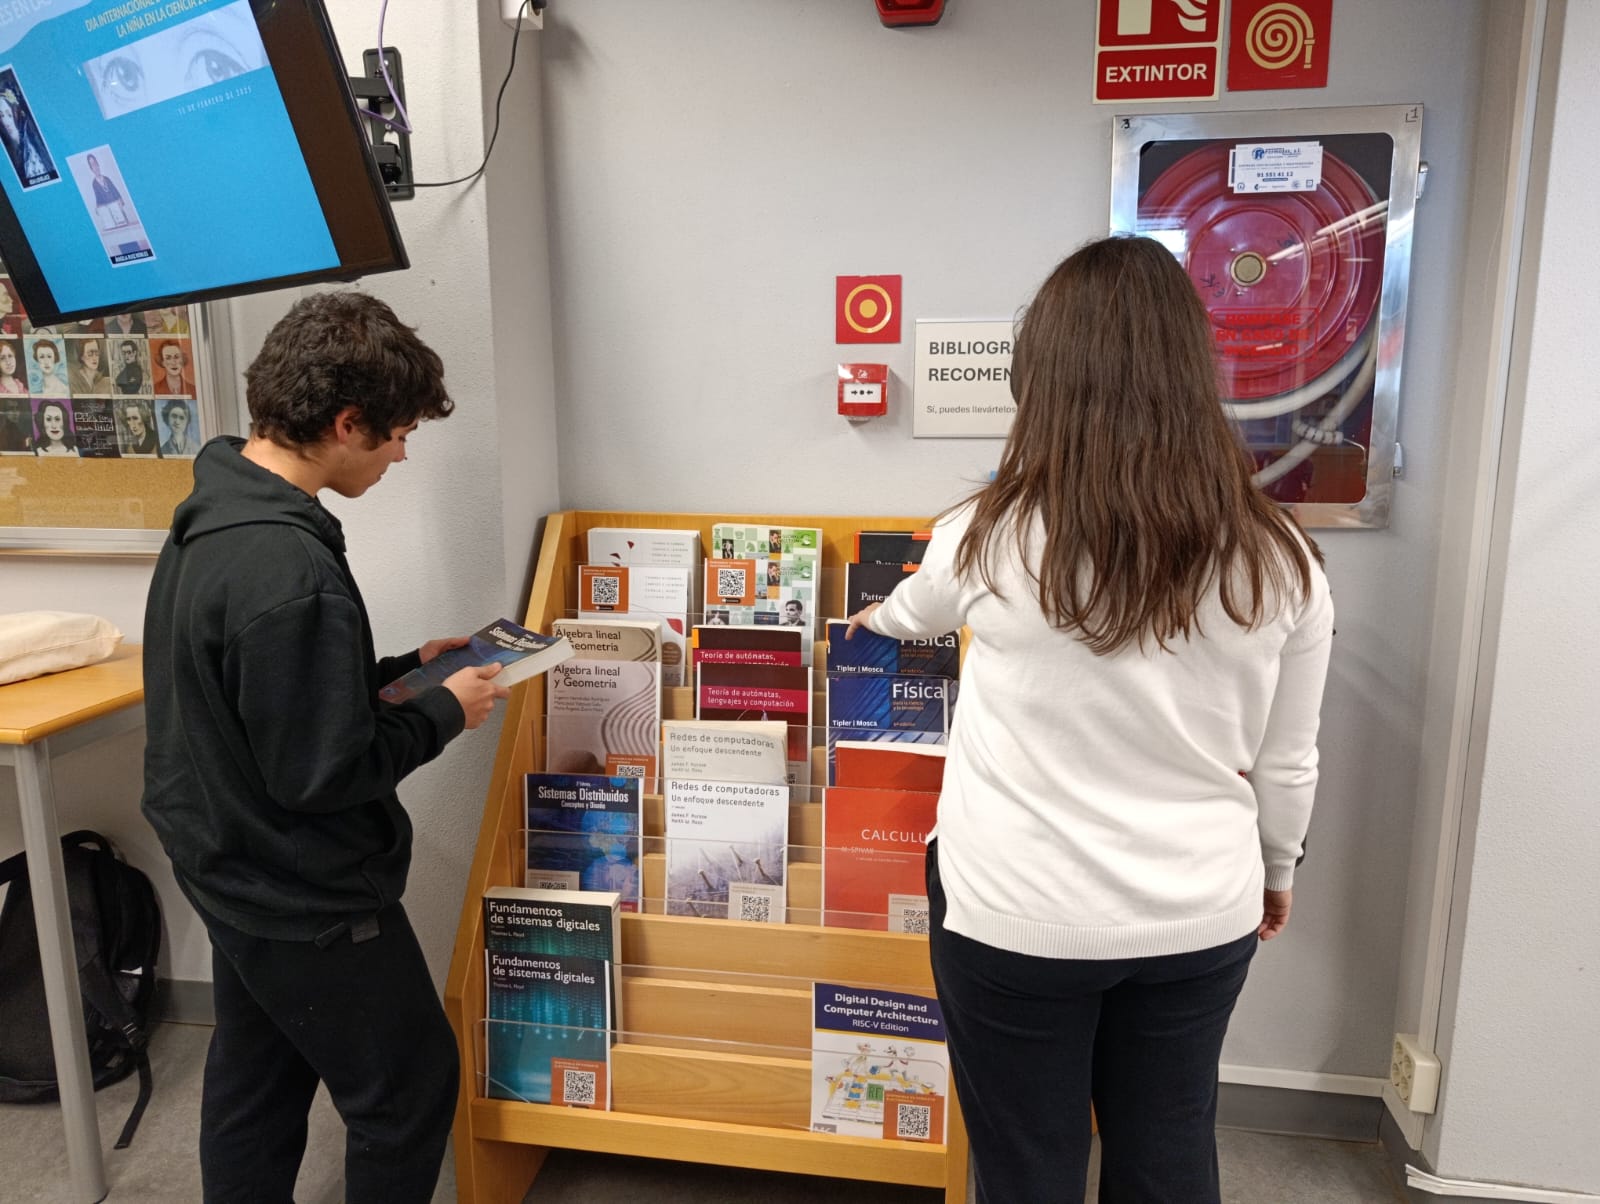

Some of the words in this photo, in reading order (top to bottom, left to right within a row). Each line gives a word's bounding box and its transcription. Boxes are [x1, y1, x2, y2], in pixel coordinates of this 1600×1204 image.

[1105, 63, 1207, 83] EXTINTOR
[929, 341, 1014, 355] BIBLIOGR
[939, 406, 970, 414] puedes
[596, 629, 621, 640] lineal
[595, 666, 620, 676] lineal
[554, 679, 560, 688] y
[893, 682, 944, 699] Física
[731, 688, 740, 696] de
[708, 697, 741, 706] lenguajes
[750, 699, 794, 707] computación
[670, 733, 697, 741] Redes
[700, 734, 711, 742] de
[713, 736, 774, 749] computadoras
[682, 745, 712, 754] enfoque
[715, 747, 762, 756] descendente
[538, 786, 577, 800] Sistemas
[579, 788, 629, 803] Distribuidos
[671, 781, 699, 791] Redes
[702, 783, 713, 791] de
[715, 785, 780, 796] computadoras
[683, 796, 714, 804] enfoque
[716, 798, 765, 807] descendente
[490, 902, 563, 917] Fundamentos
[490, 913, 504, 924] de
[507, 915, 553, 927] sistemas
[556, 918, 600, 931] digitales
[492, 955, 561, 970] Fundamentos
[493, 966, 506, 976] de
[508, 968, 551, 980] sistemas
[554, 971, 595, 984] digitales
[834, 993, 868, 1005] Digital
[870, 998, 906, 1010] Design
[907, 1004, 928, 1013] and
[823, 1004, 874, 1017] Computer
[875, 1010, 939, 1026] Architecture
[852, 1019, 879, 1029] RISC-V
[880, 1022, 909, 1032] Edition
